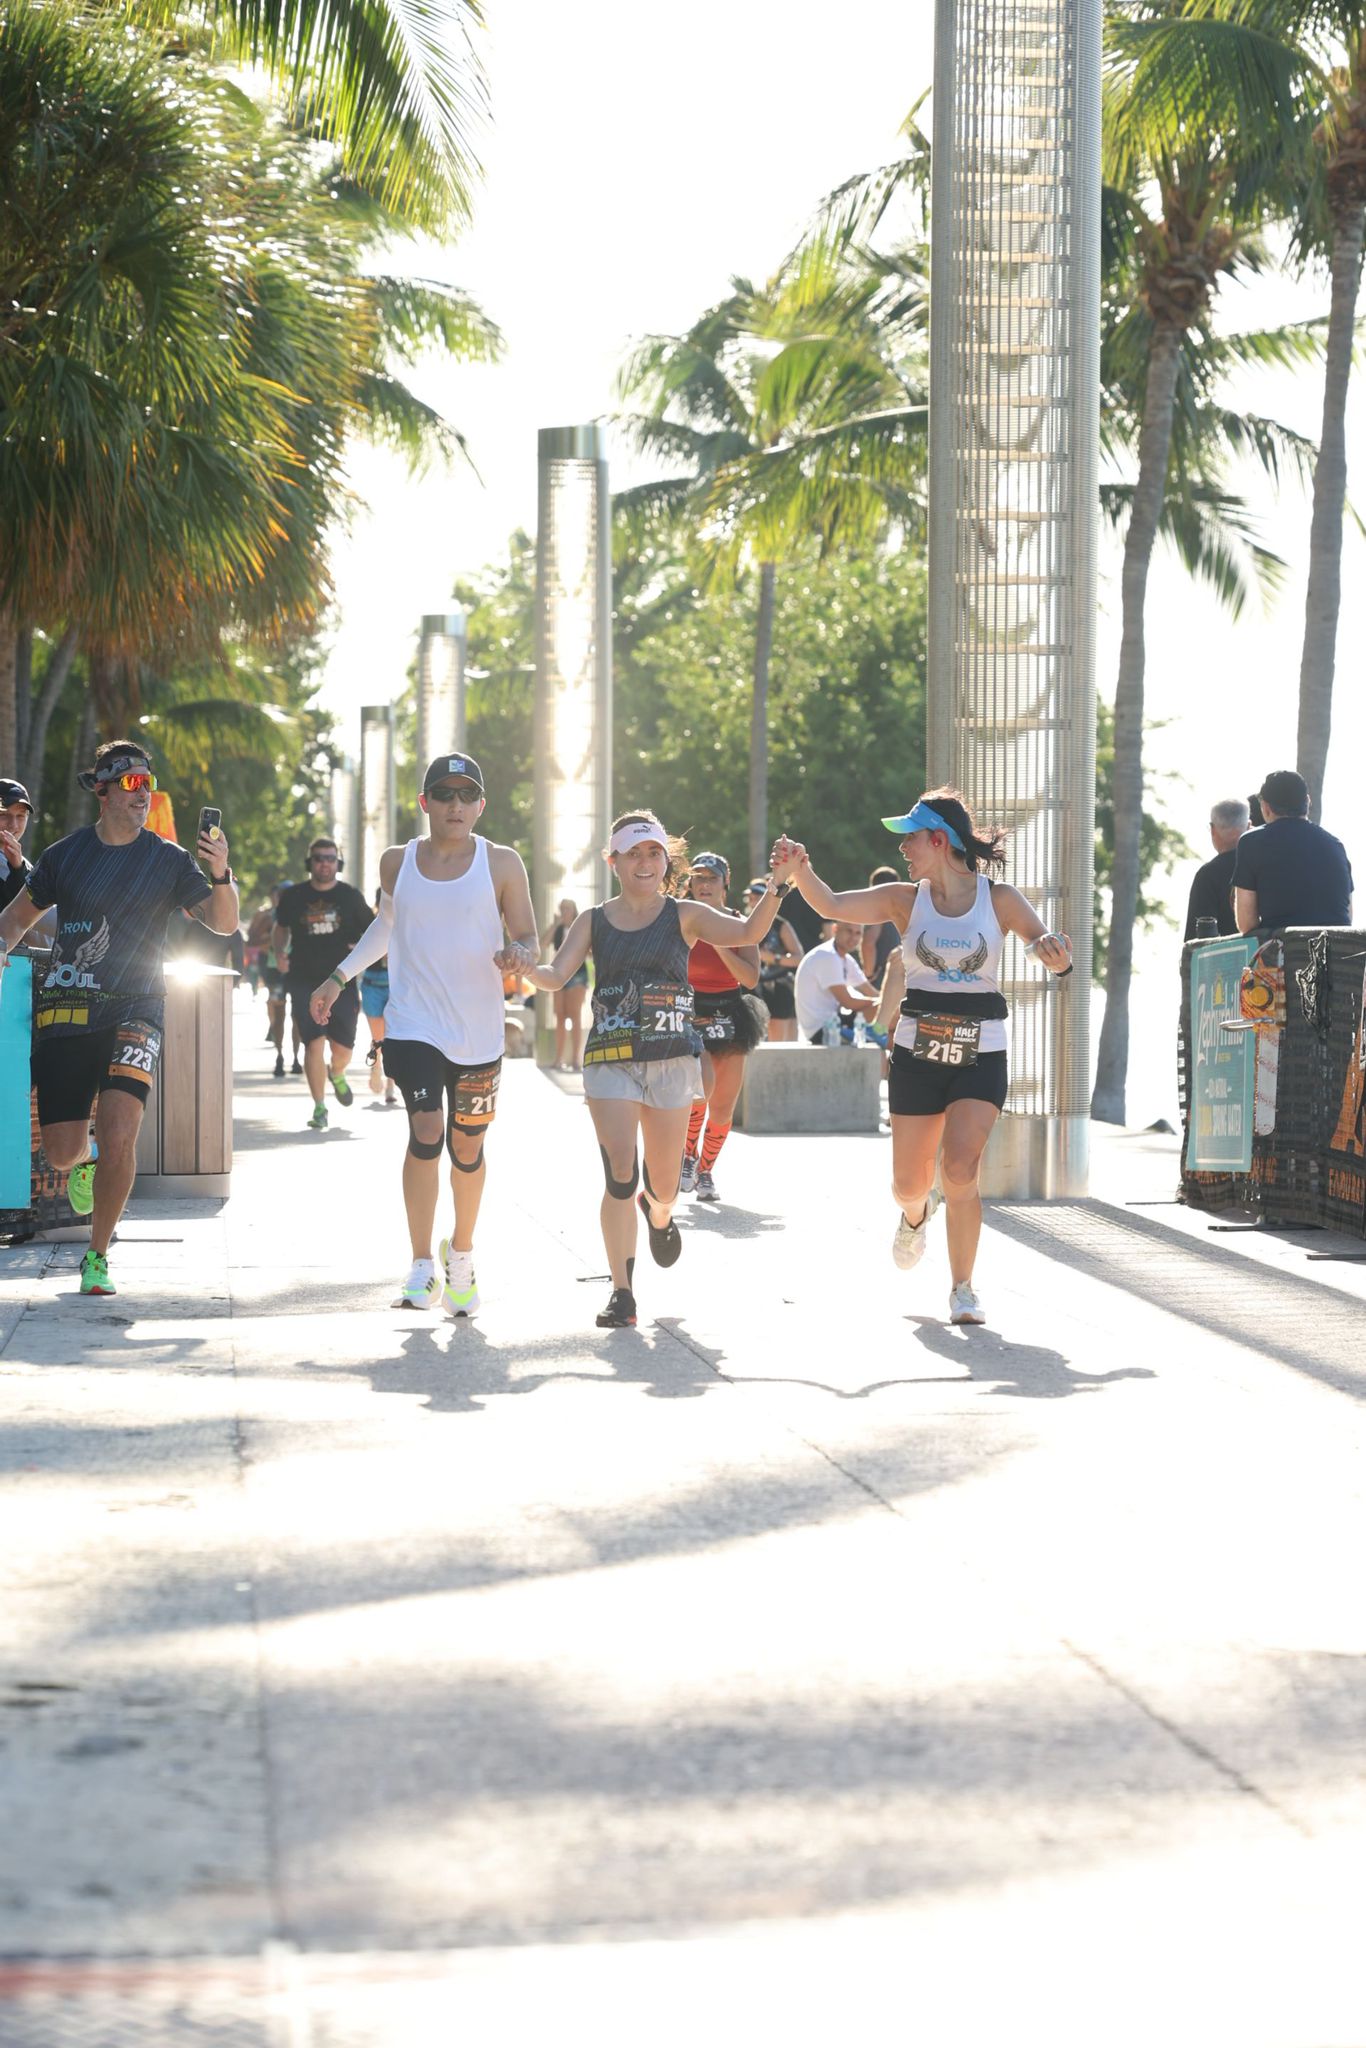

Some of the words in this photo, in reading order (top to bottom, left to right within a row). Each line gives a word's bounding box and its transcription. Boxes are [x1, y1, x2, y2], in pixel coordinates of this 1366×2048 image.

[60, 921, 92, 934] RON
[936, 936, 971, 949] IRON
[44, 963, 101, 990] SOUL
[938, 967, 981, 983] SOUL
[705, 1024, 726, 1039] 33
[954, 1026, 978, 1038] HALF
[119, 1045, 153, 1072] 223
[927, 1040, 963, 1064] 215
